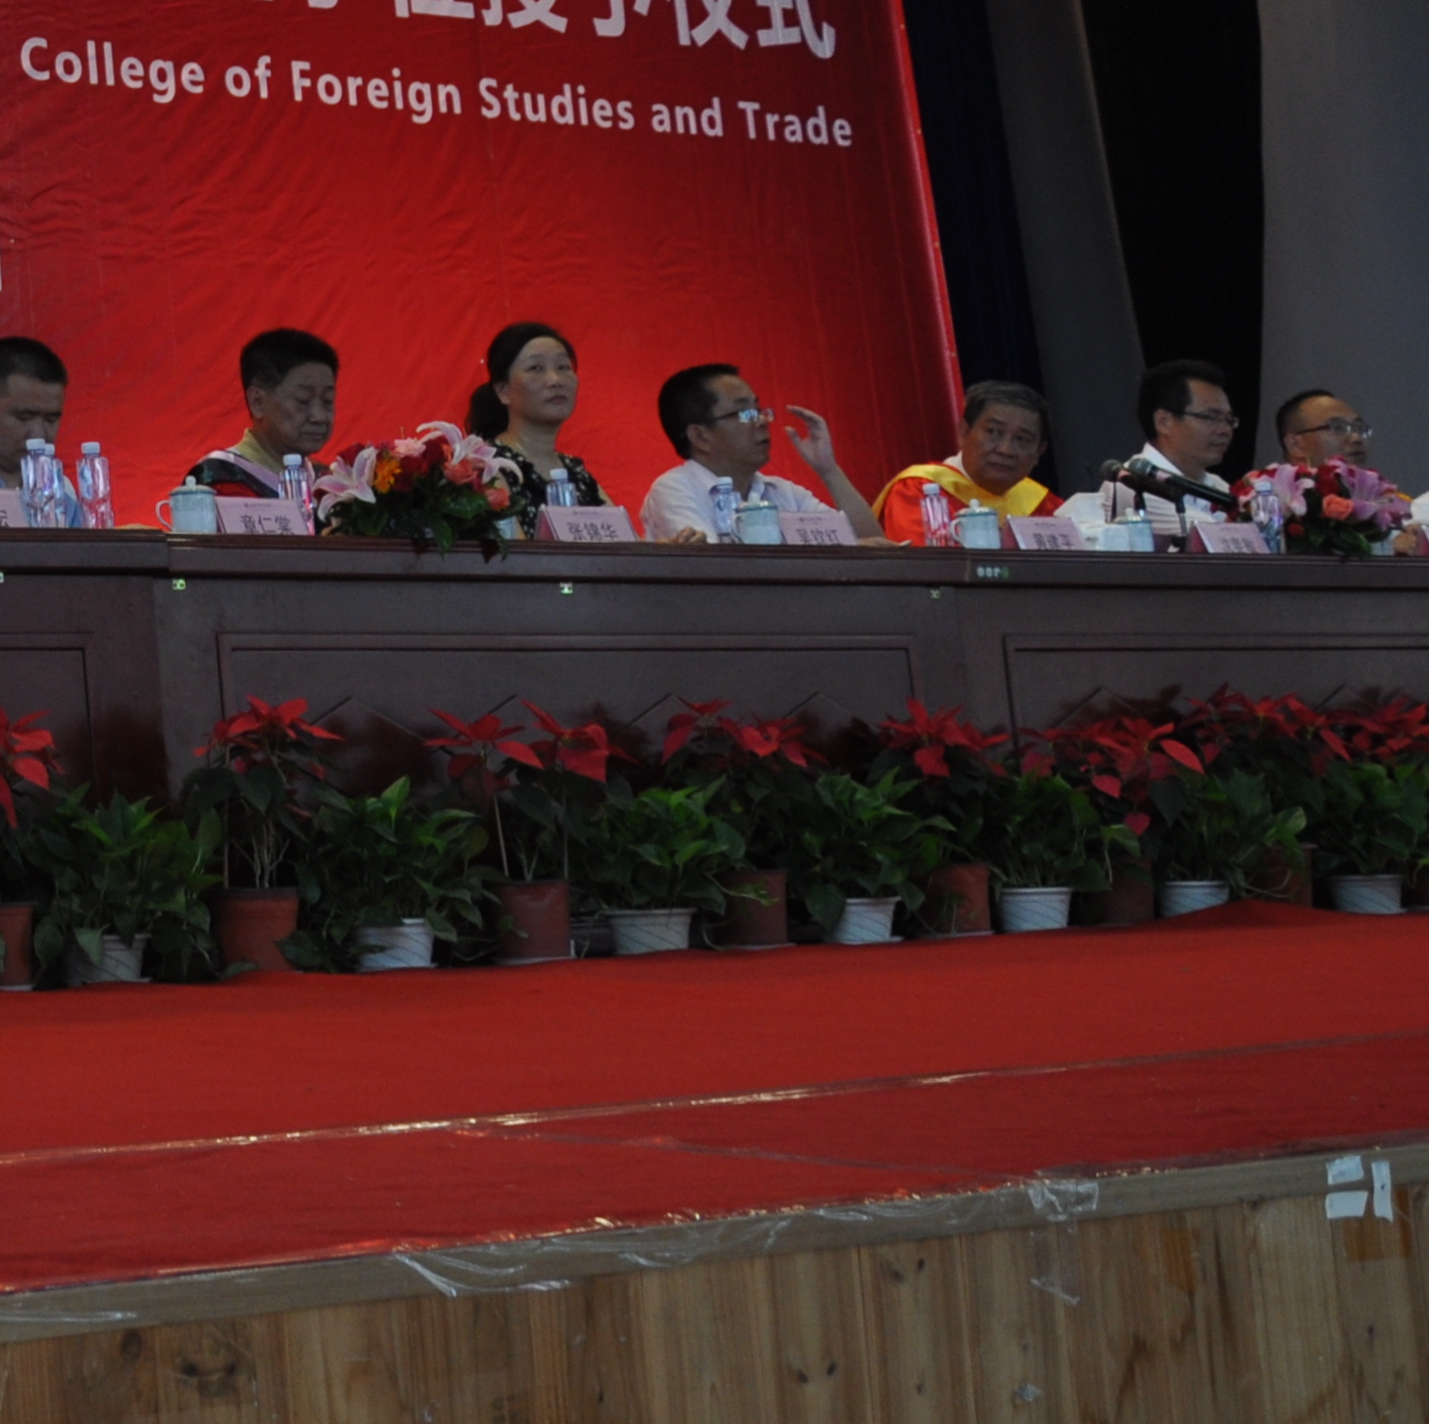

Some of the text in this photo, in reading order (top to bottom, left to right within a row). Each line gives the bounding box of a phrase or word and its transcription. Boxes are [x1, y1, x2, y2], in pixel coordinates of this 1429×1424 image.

[20, 36, 205, 104] College
[224, 54, 272, 99] of
[290, 60, 462, 124] Foreign
[478, 77, 635, 130] Studies
[651, 96, 724, 137] and
[737, 101, 853, 147] Trade
